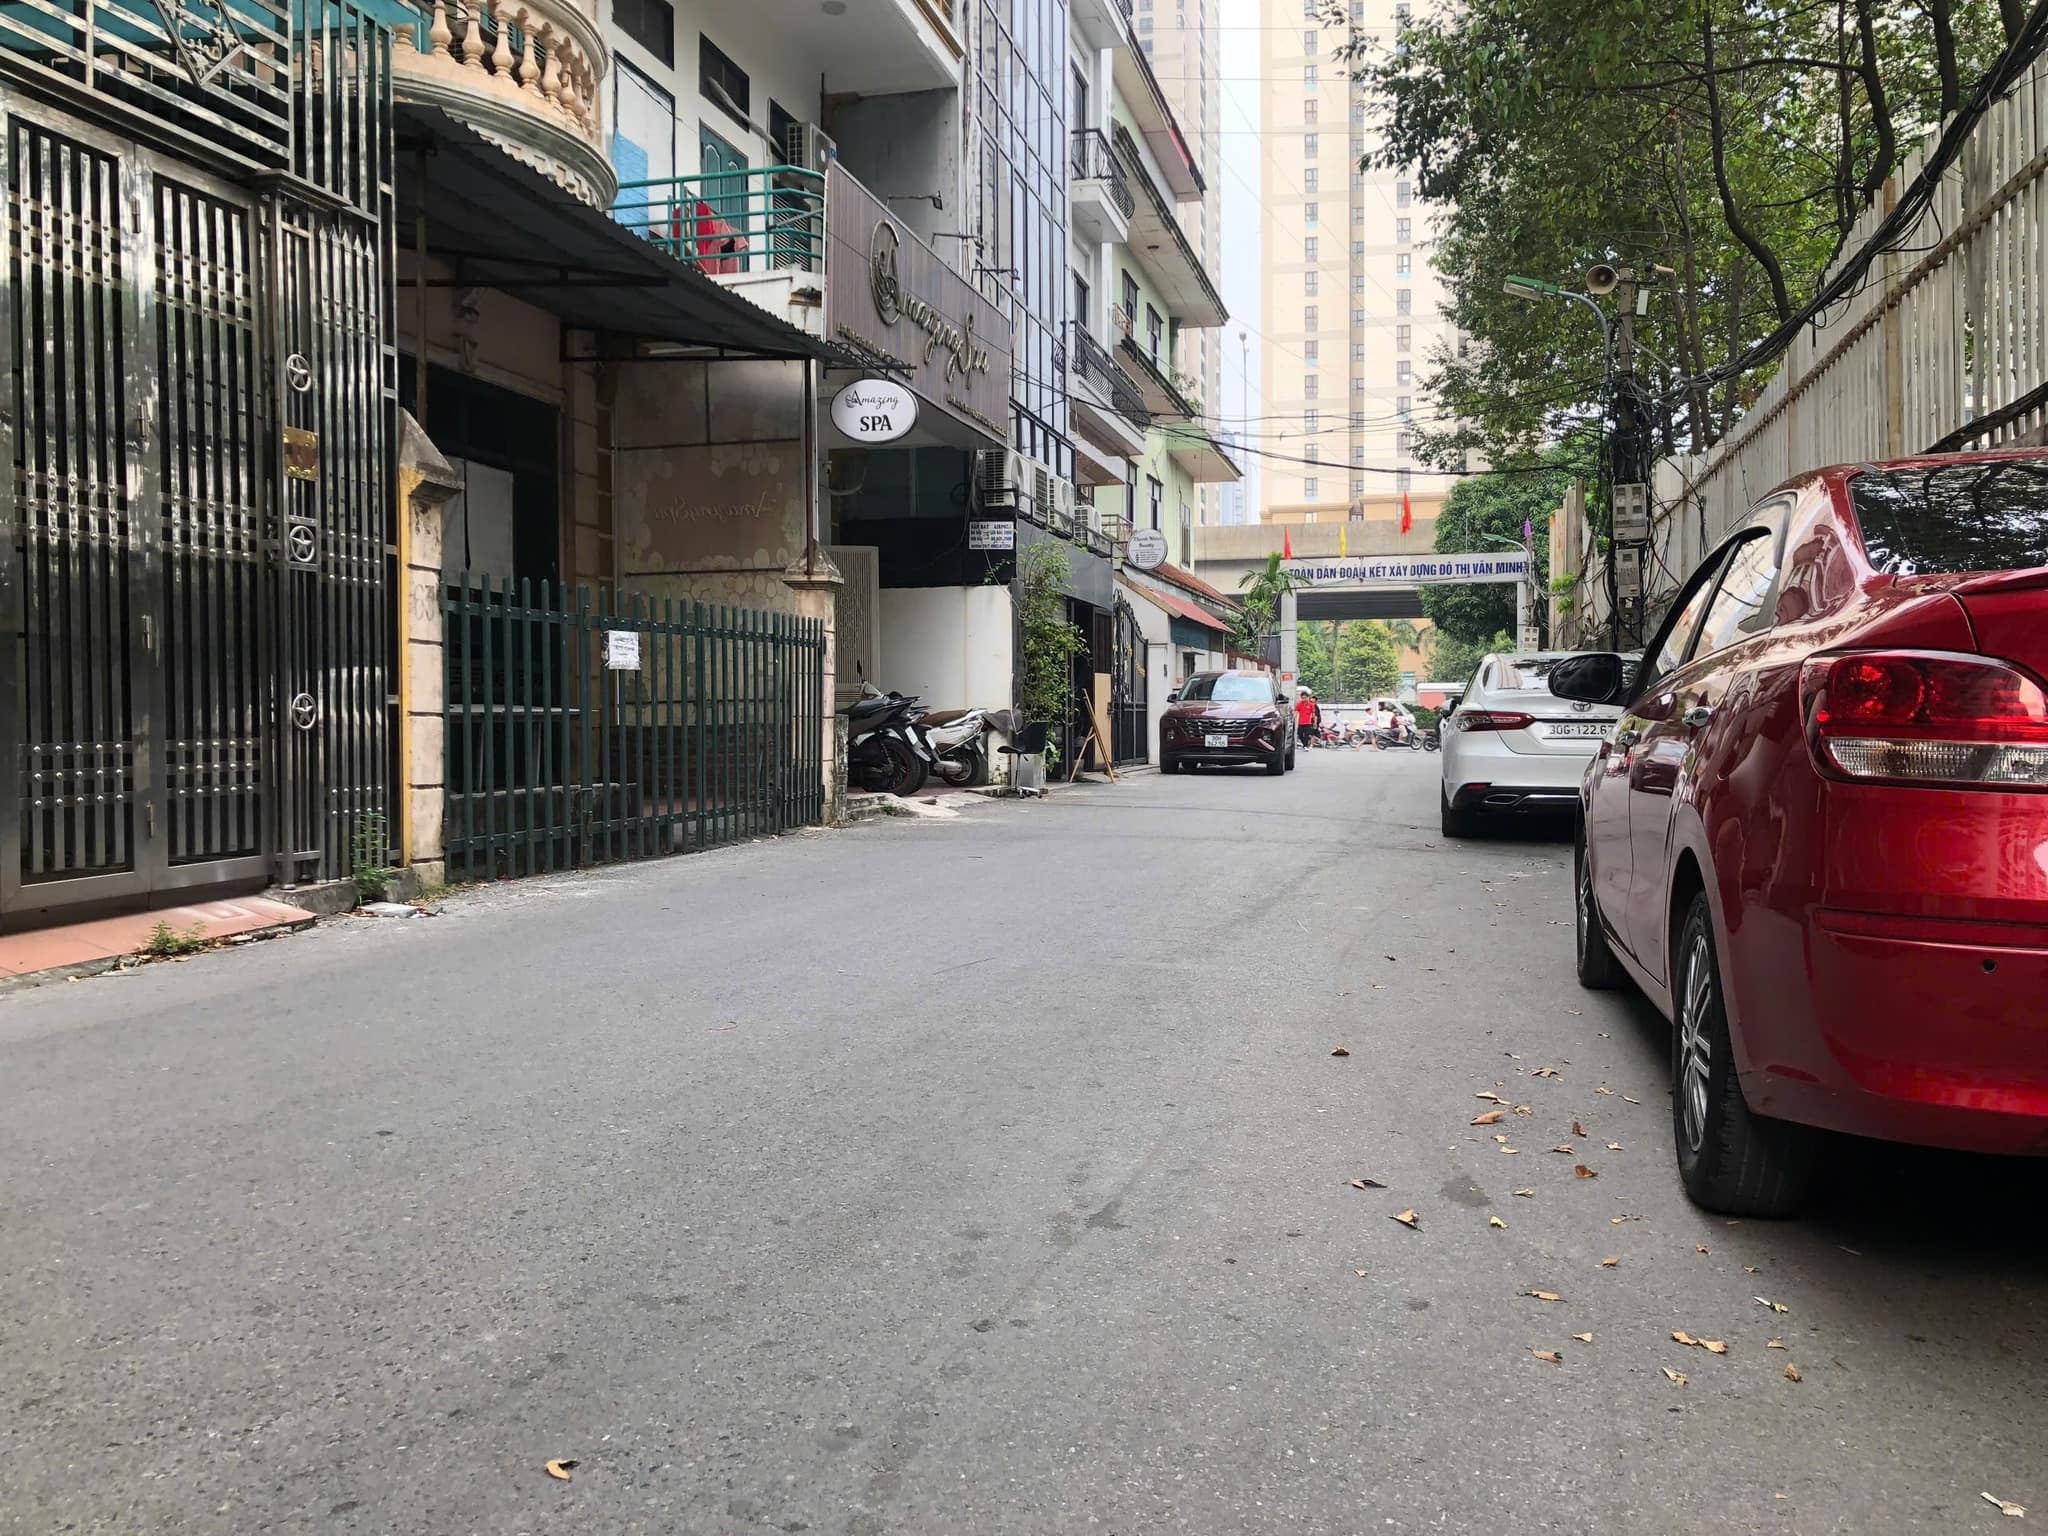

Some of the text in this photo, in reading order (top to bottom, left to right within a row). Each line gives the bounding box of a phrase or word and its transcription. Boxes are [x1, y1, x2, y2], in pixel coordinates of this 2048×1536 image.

[845, 390, 898, 410] Amazing
[860, 414, 893, 431] SPA
[1316, 565, 1336, 579] DÂN
[1369, 562, 1387, 577] KẾT
[1389, 562, 1408, 577] XÂY
[1410, 563, 1436, 578] DỰNG
[1439, 561, 1452, 575] ĐÔ
[1455, 563, 1470, 577] THỊ
[1472, 560, 1492, 574] VĂN
[1496, 561, 1523, 574] MINH
